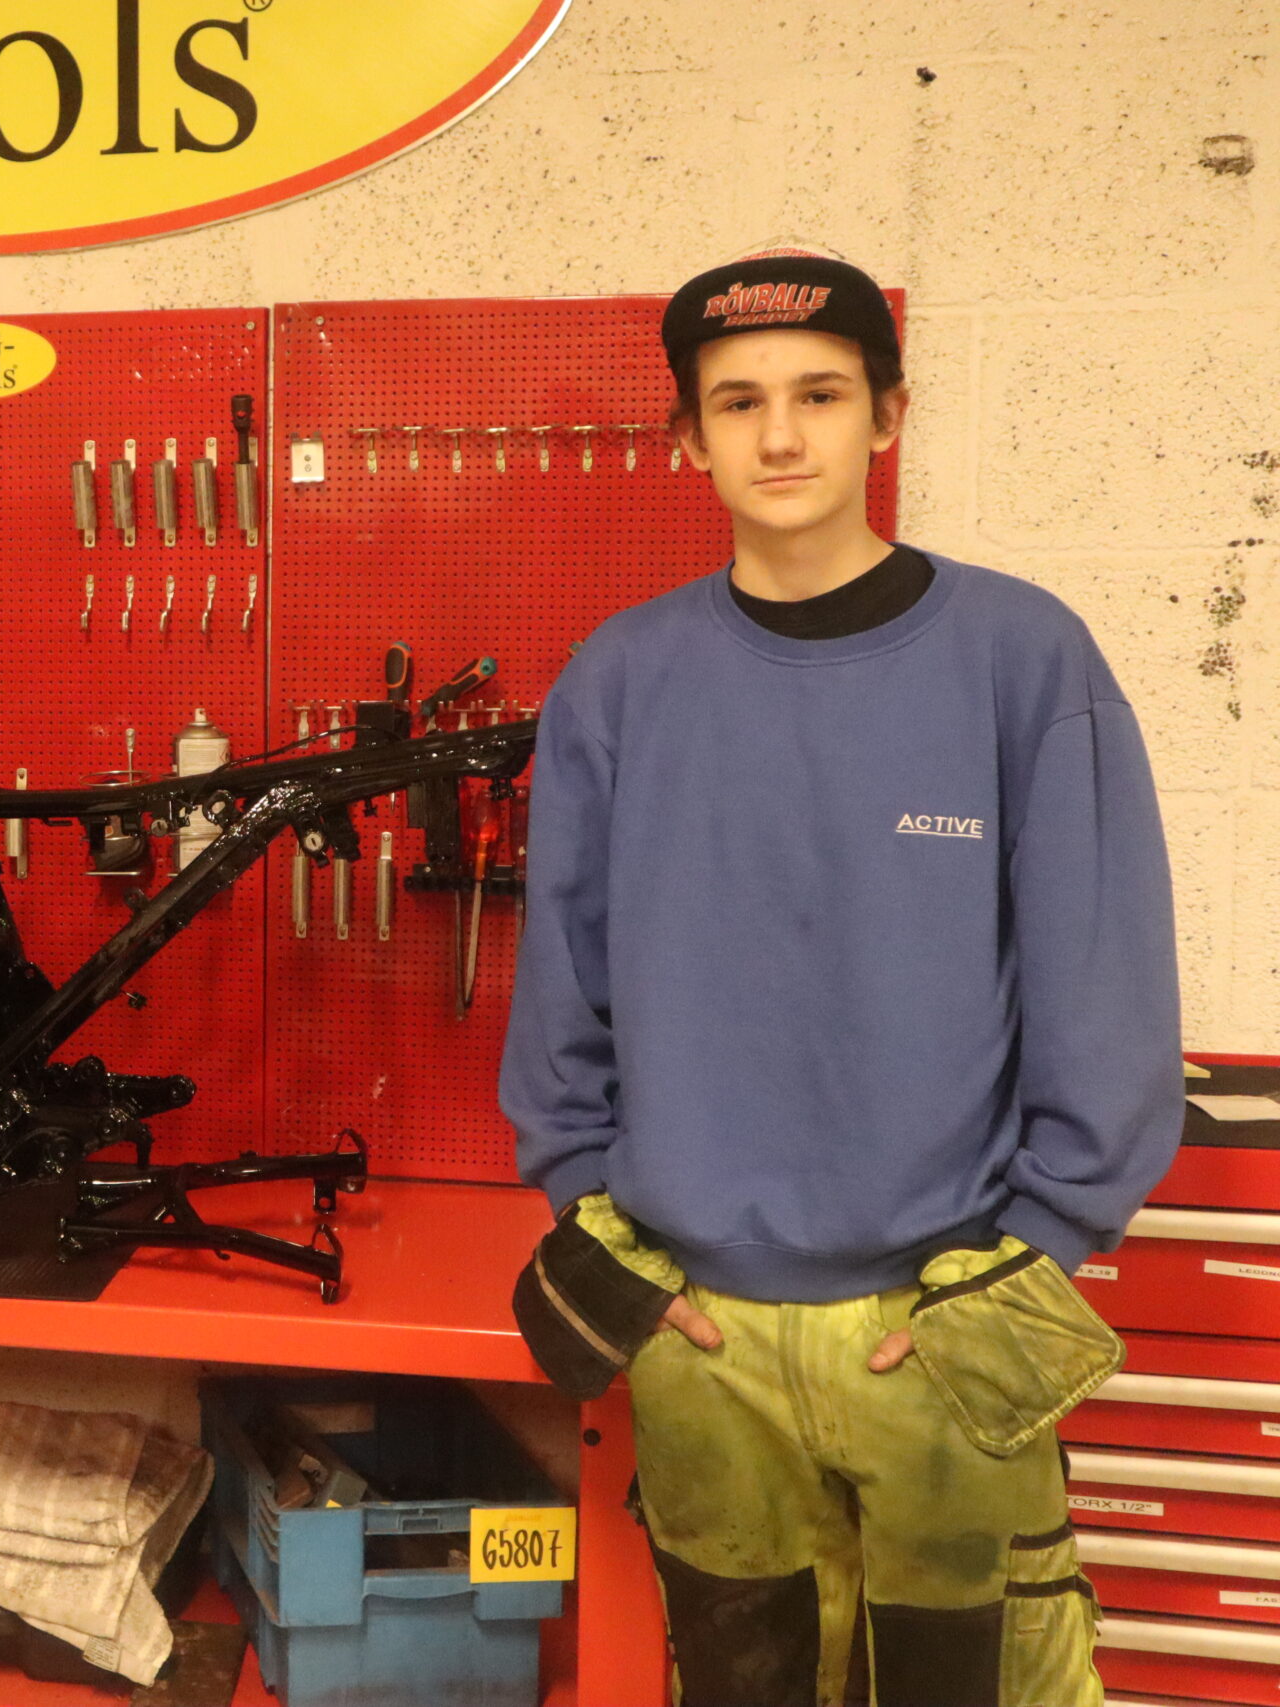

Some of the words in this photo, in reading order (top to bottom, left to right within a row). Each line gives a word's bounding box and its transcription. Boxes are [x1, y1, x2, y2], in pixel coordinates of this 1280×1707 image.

[703, 281, 832, 319] RÖVBALLE
[897, 813, 984, 835] ACTIVE
[1070, 1496, 1113, 1509] ORX
[1120, 1501, 1152, 1512] 1/2"
[482, 1528, 563, 1571] 65807
